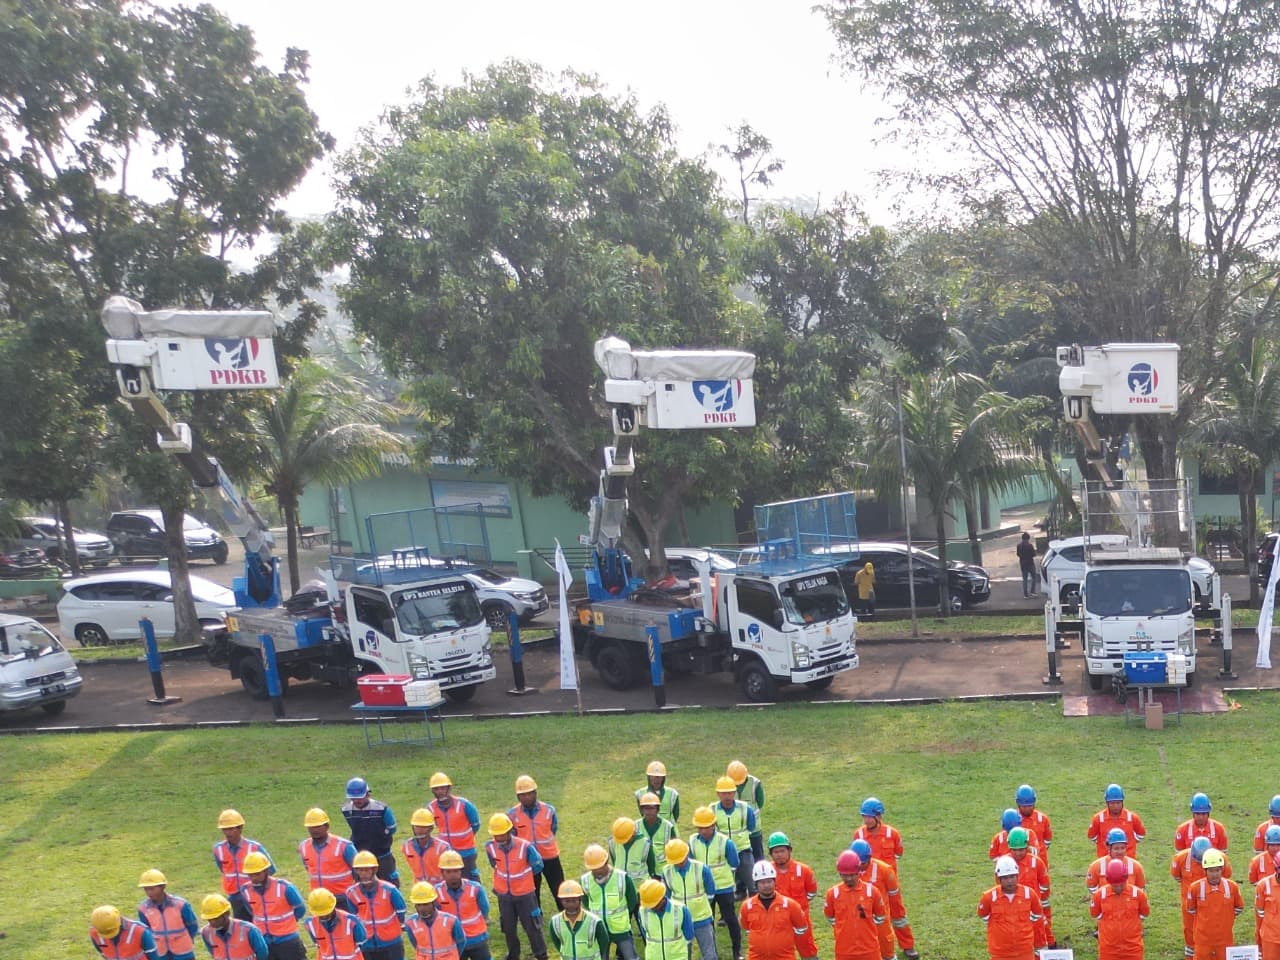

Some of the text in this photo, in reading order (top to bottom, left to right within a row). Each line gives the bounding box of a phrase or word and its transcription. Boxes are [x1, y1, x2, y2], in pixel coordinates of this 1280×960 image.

[210, 370, 267, 384] PDKB
[704, 413, 736, 423] PDKB
[446, 649, 466, 657] ISUZU
